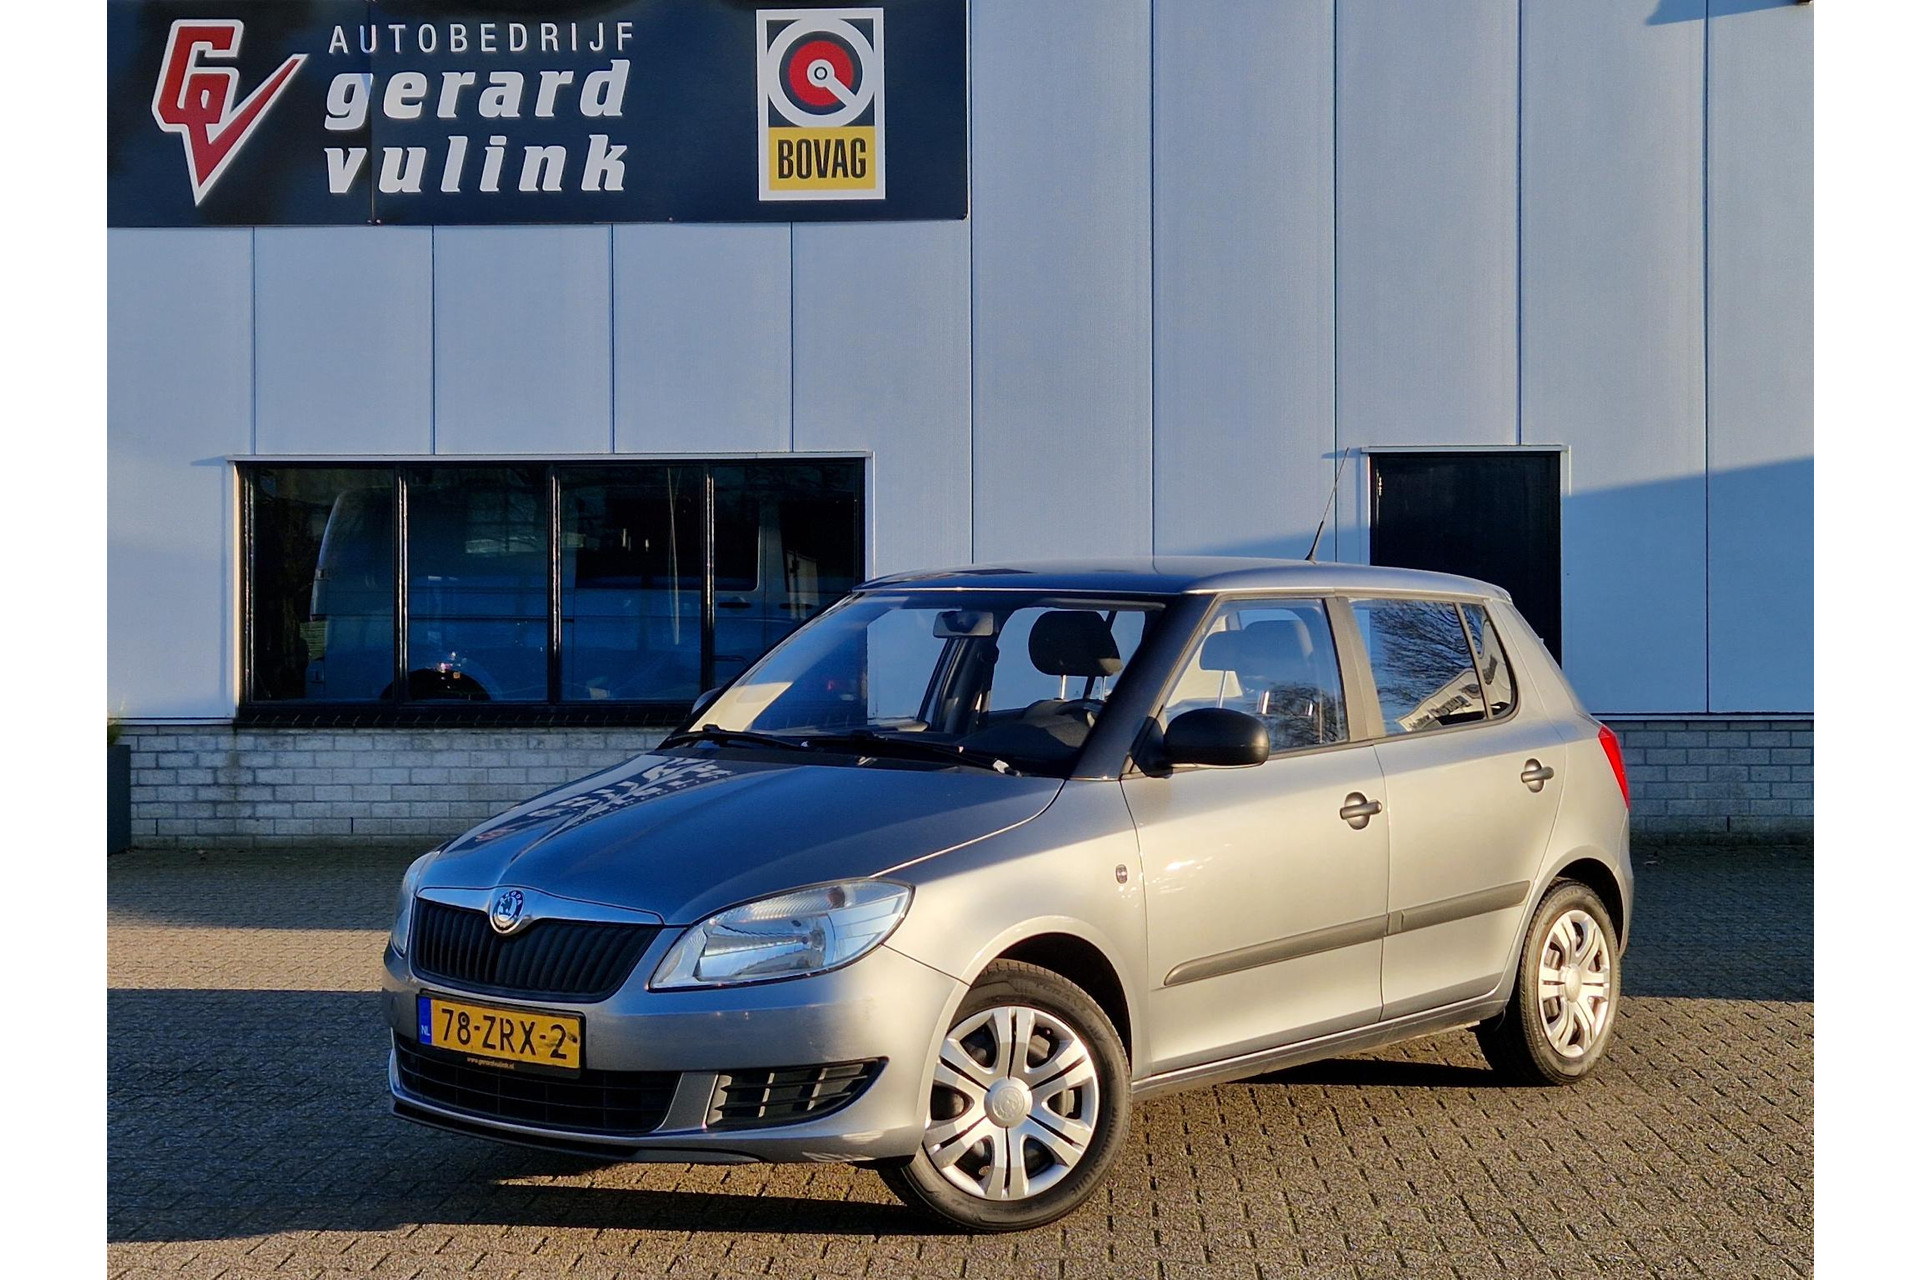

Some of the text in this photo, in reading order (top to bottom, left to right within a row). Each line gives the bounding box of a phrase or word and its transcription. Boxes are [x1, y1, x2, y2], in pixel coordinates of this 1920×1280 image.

[328, 22, 634, 54] AUTOBEDRIJF
[324, 59, 631, 131] gerard
[323, 134, 628, 194] vulink
[777, 137, 867, 180] BOVAG
[420, 1024, 431, 1036] NL
[441, 1008, 568, 1060] 78-ZRX-2
